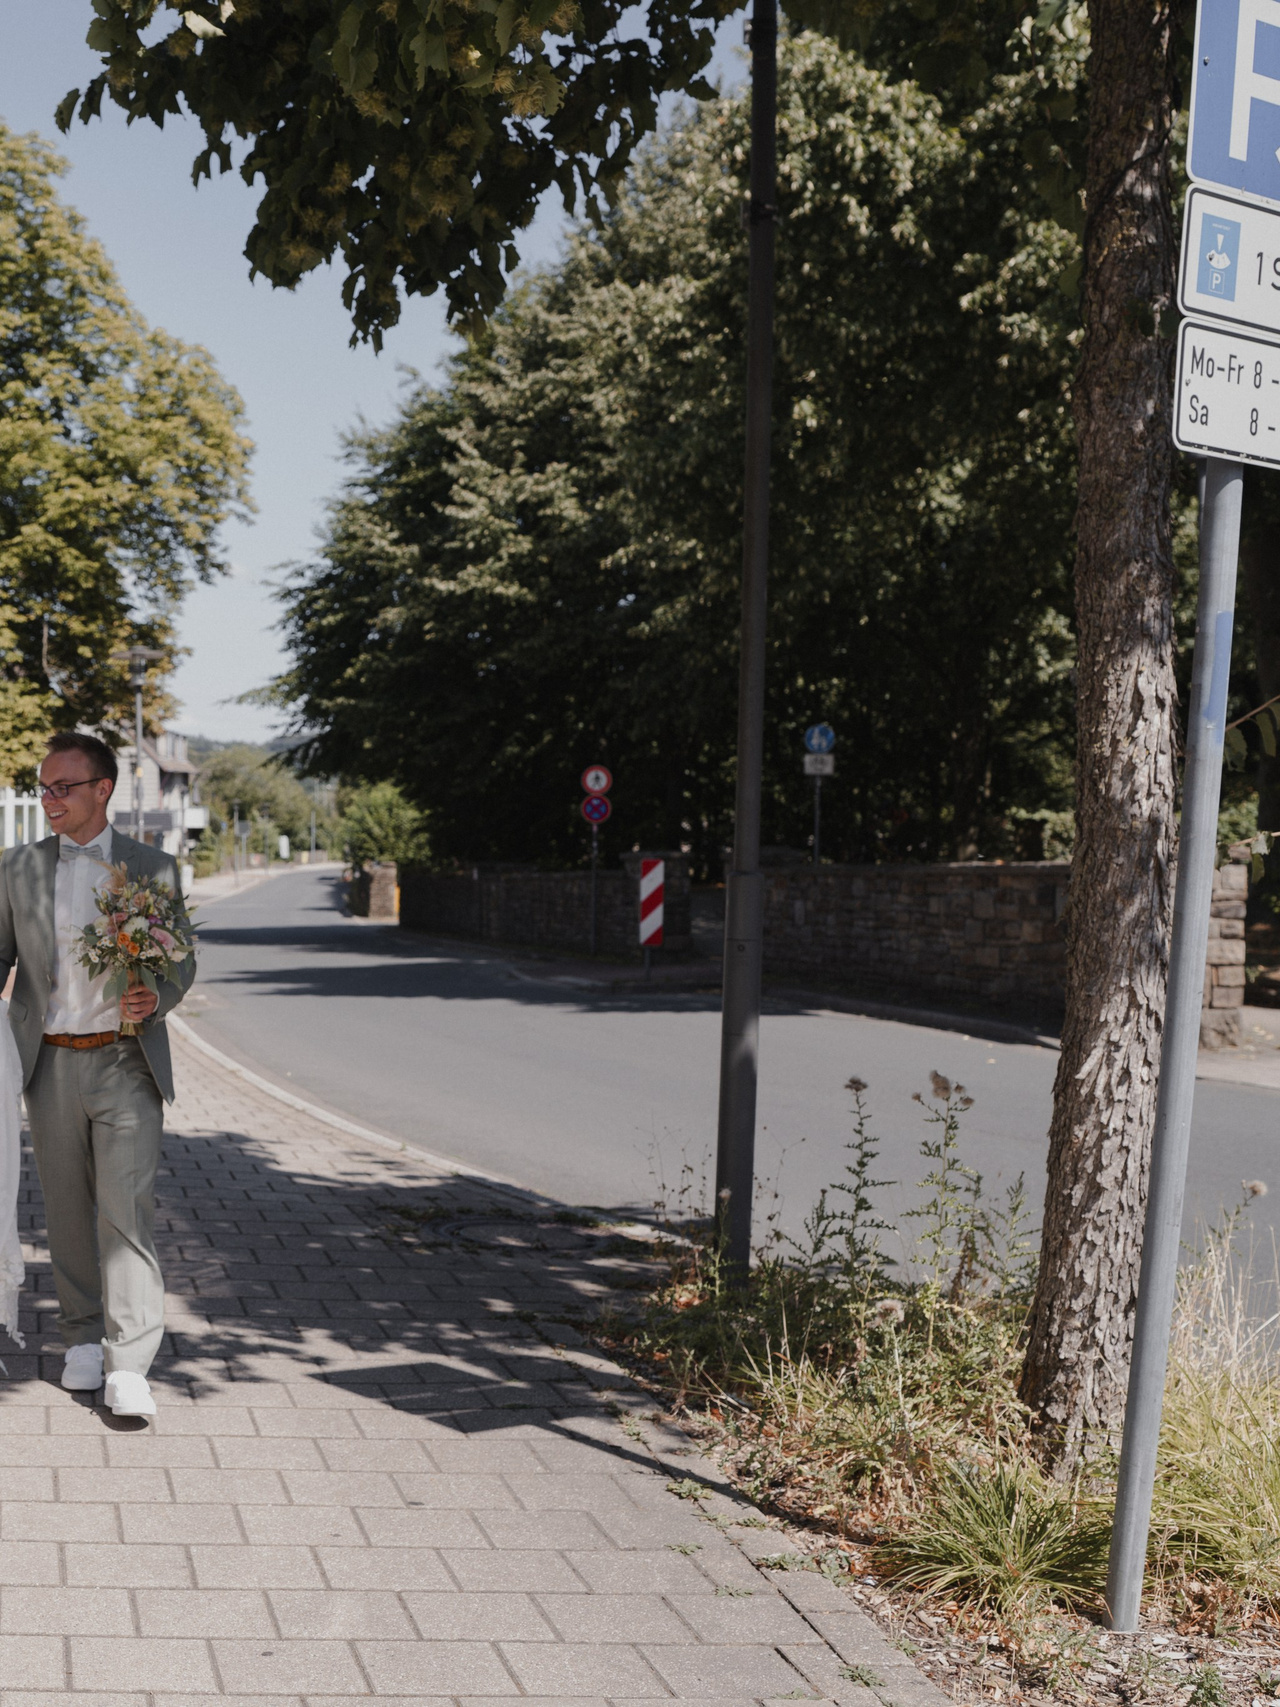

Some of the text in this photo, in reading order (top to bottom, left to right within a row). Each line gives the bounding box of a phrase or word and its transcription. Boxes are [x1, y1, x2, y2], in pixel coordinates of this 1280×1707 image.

[1190, 345, 1245, 385] Mo-Fr
[1253, 360, 1263, 389] 8
[1188, 394, 1210, 427] Sa
[1249, 408, 1259, 436] 8
